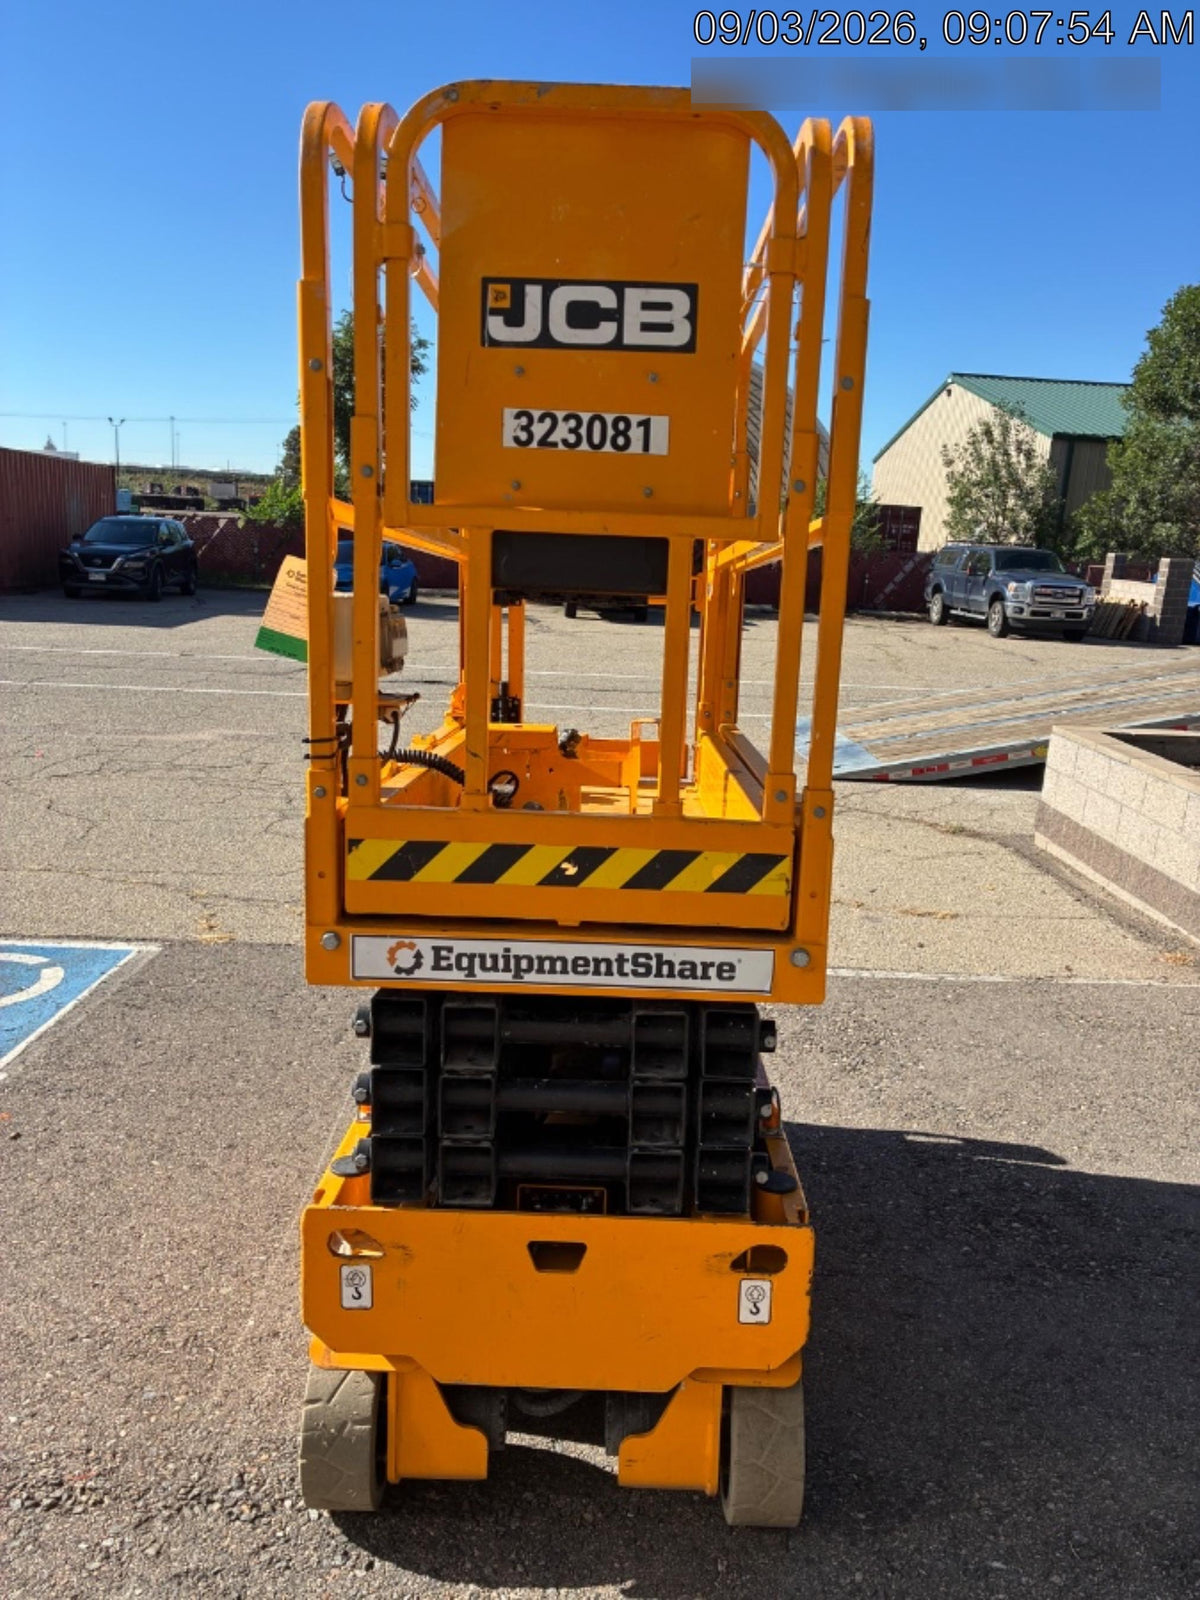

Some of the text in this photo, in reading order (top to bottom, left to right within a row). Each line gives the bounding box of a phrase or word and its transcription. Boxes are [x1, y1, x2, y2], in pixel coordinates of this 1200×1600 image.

[487, 284, 692, 347] JCB
[512, 410, 652, 453] 323081
[430, 945, 737, 982] EquipmentShare
